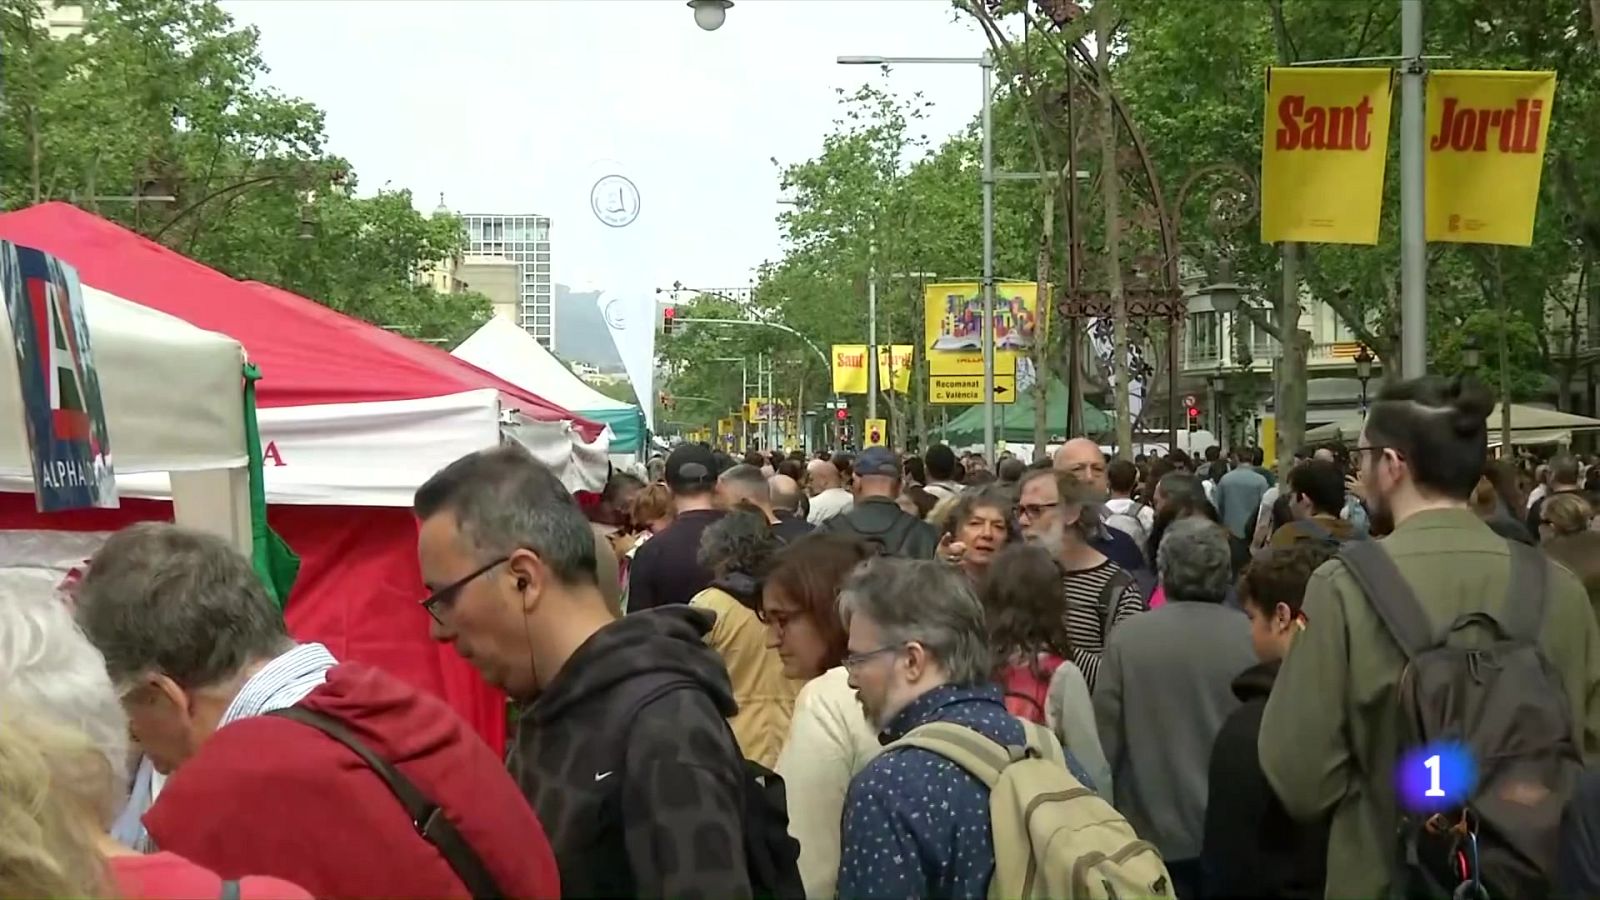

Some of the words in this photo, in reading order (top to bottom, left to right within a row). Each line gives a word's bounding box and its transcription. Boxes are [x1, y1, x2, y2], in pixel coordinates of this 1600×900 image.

[1276, 95, 1373, 151] Sant
[1430, 98, 1543, 153] Jordi
[837, 352, 863, 368] Sant
[936, 380, 979, 388] Recomanat
[43, 460, 87, 488] ALPHA
